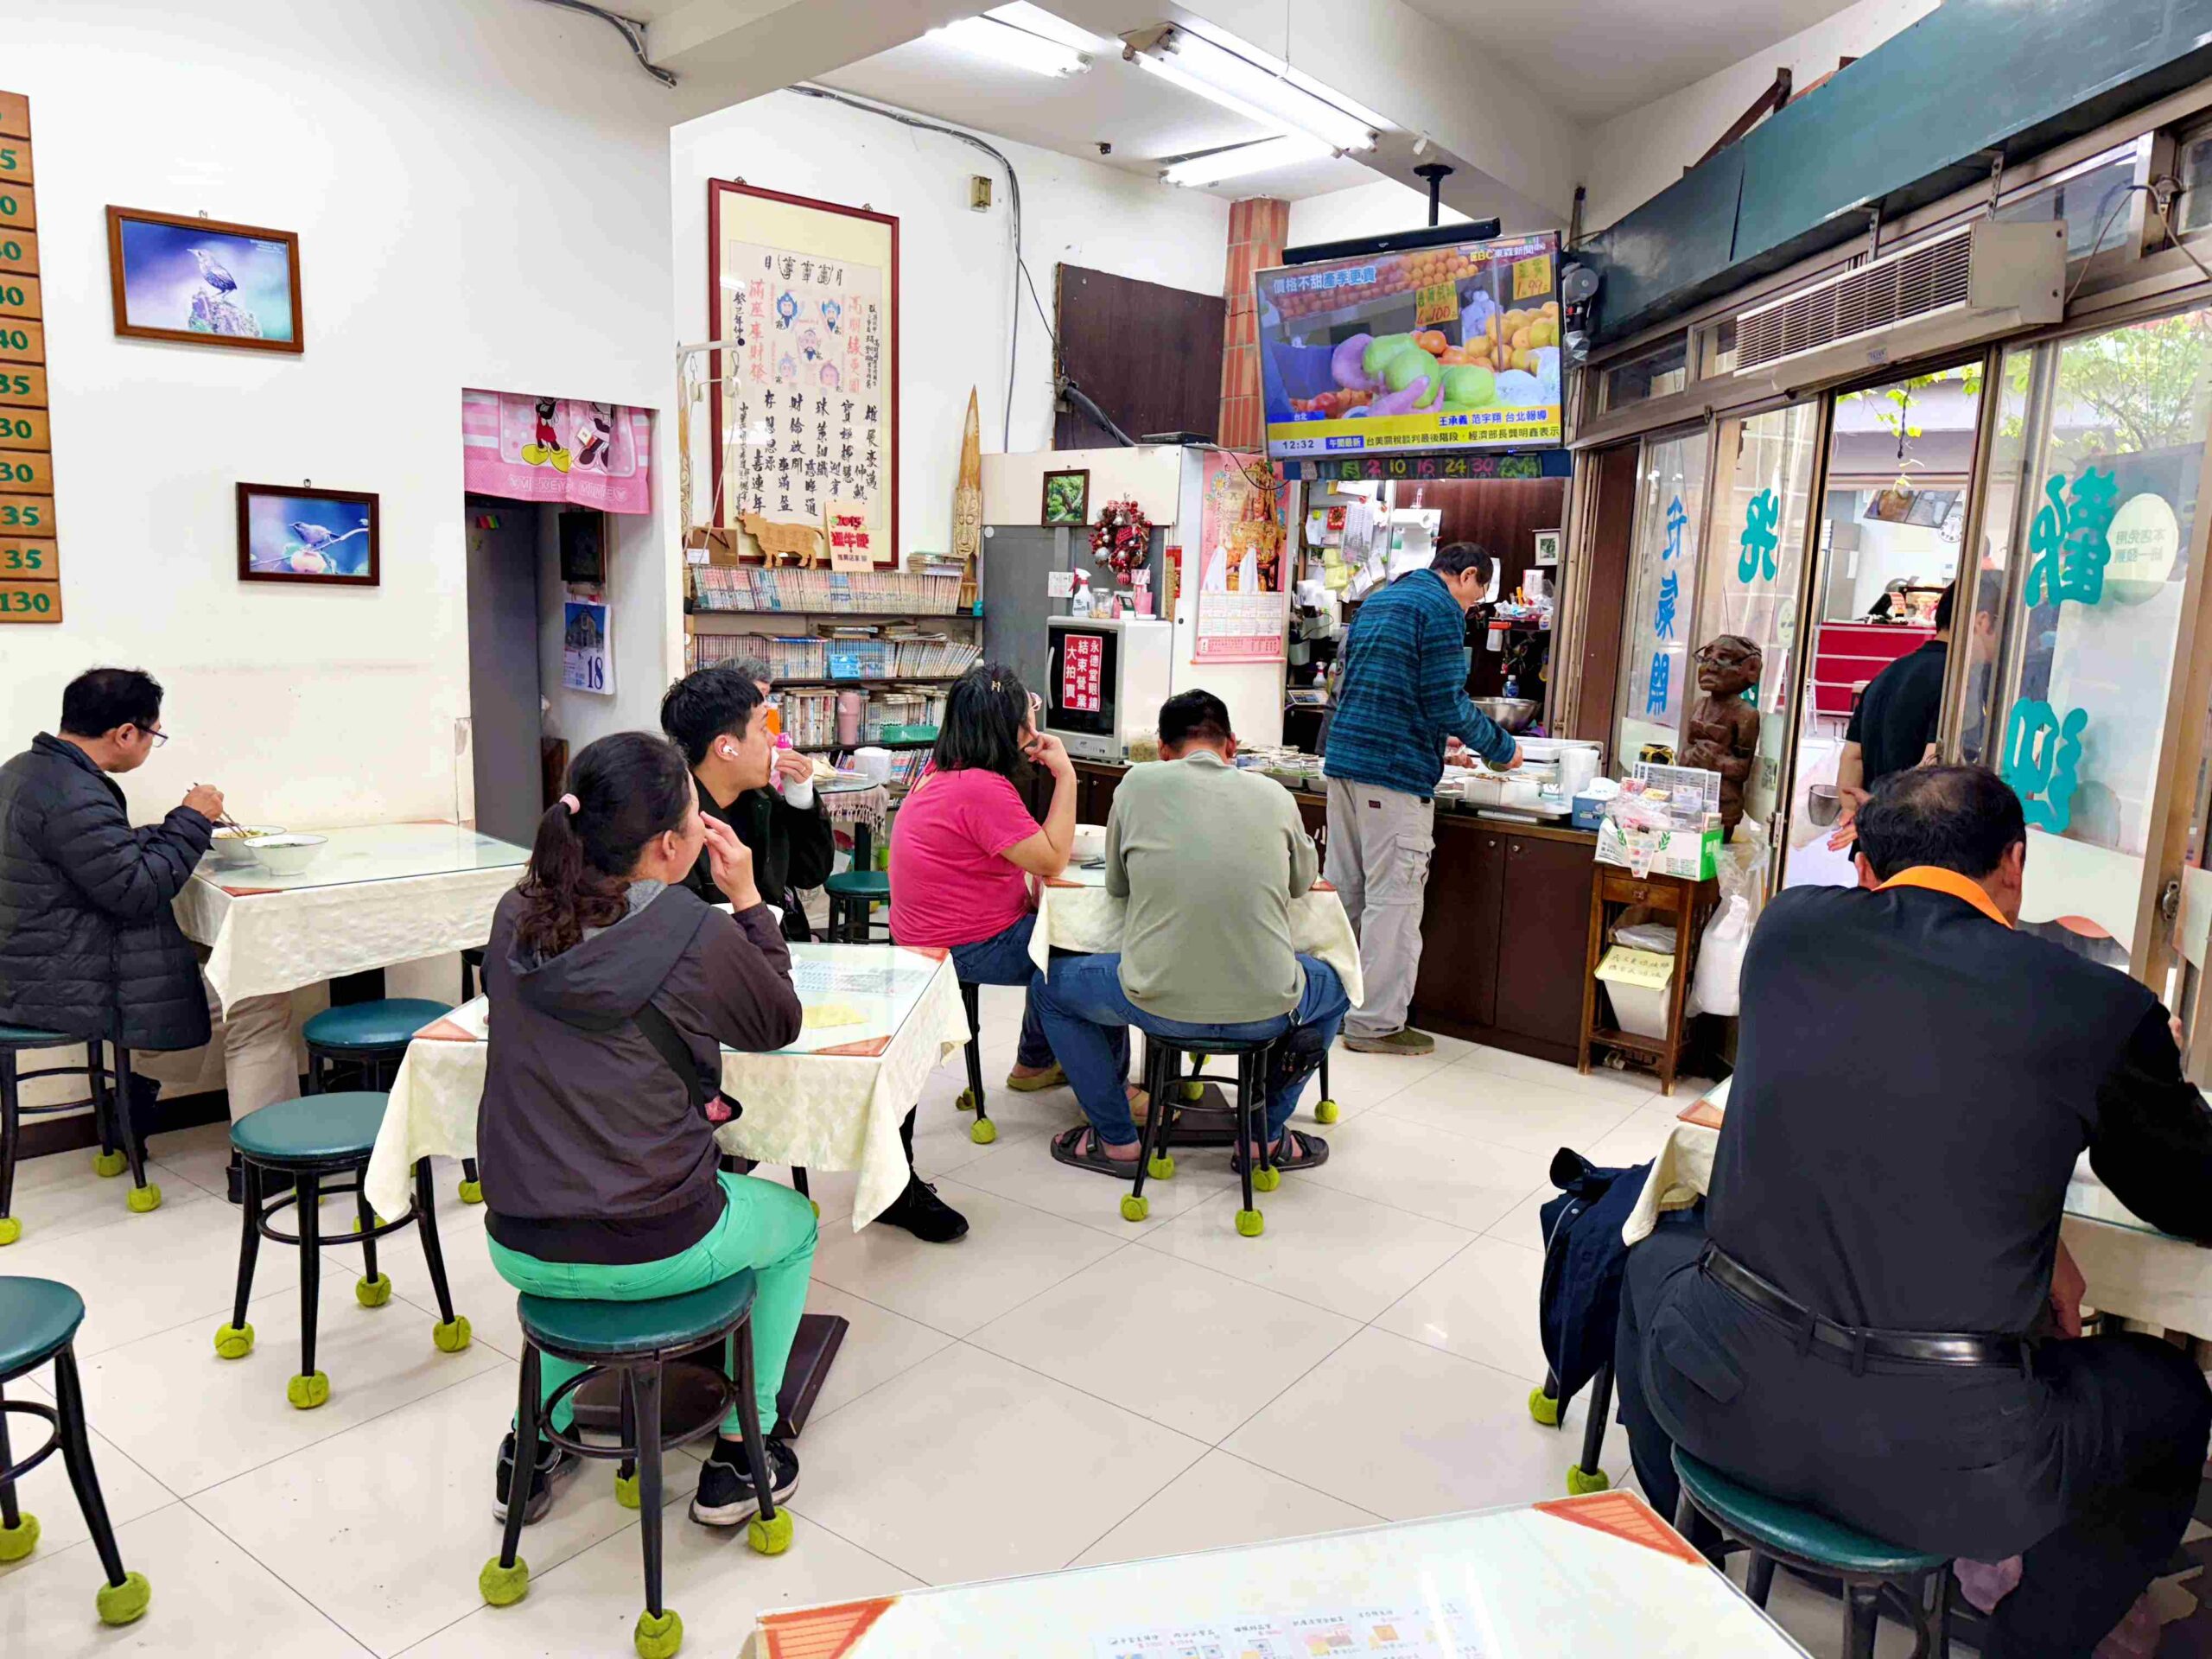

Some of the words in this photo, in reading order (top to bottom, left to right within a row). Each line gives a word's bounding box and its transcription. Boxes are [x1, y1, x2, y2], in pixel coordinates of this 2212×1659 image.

[1282, 440, 1314, 450] 12:32
[1, 505, 40, 527] 35
[3, 548, 42, 569] 35
[0, 591, 50, 613] 130
[588, 656, 604, 690] 18
[1065, 645, 1077, 698] 大拍賣
